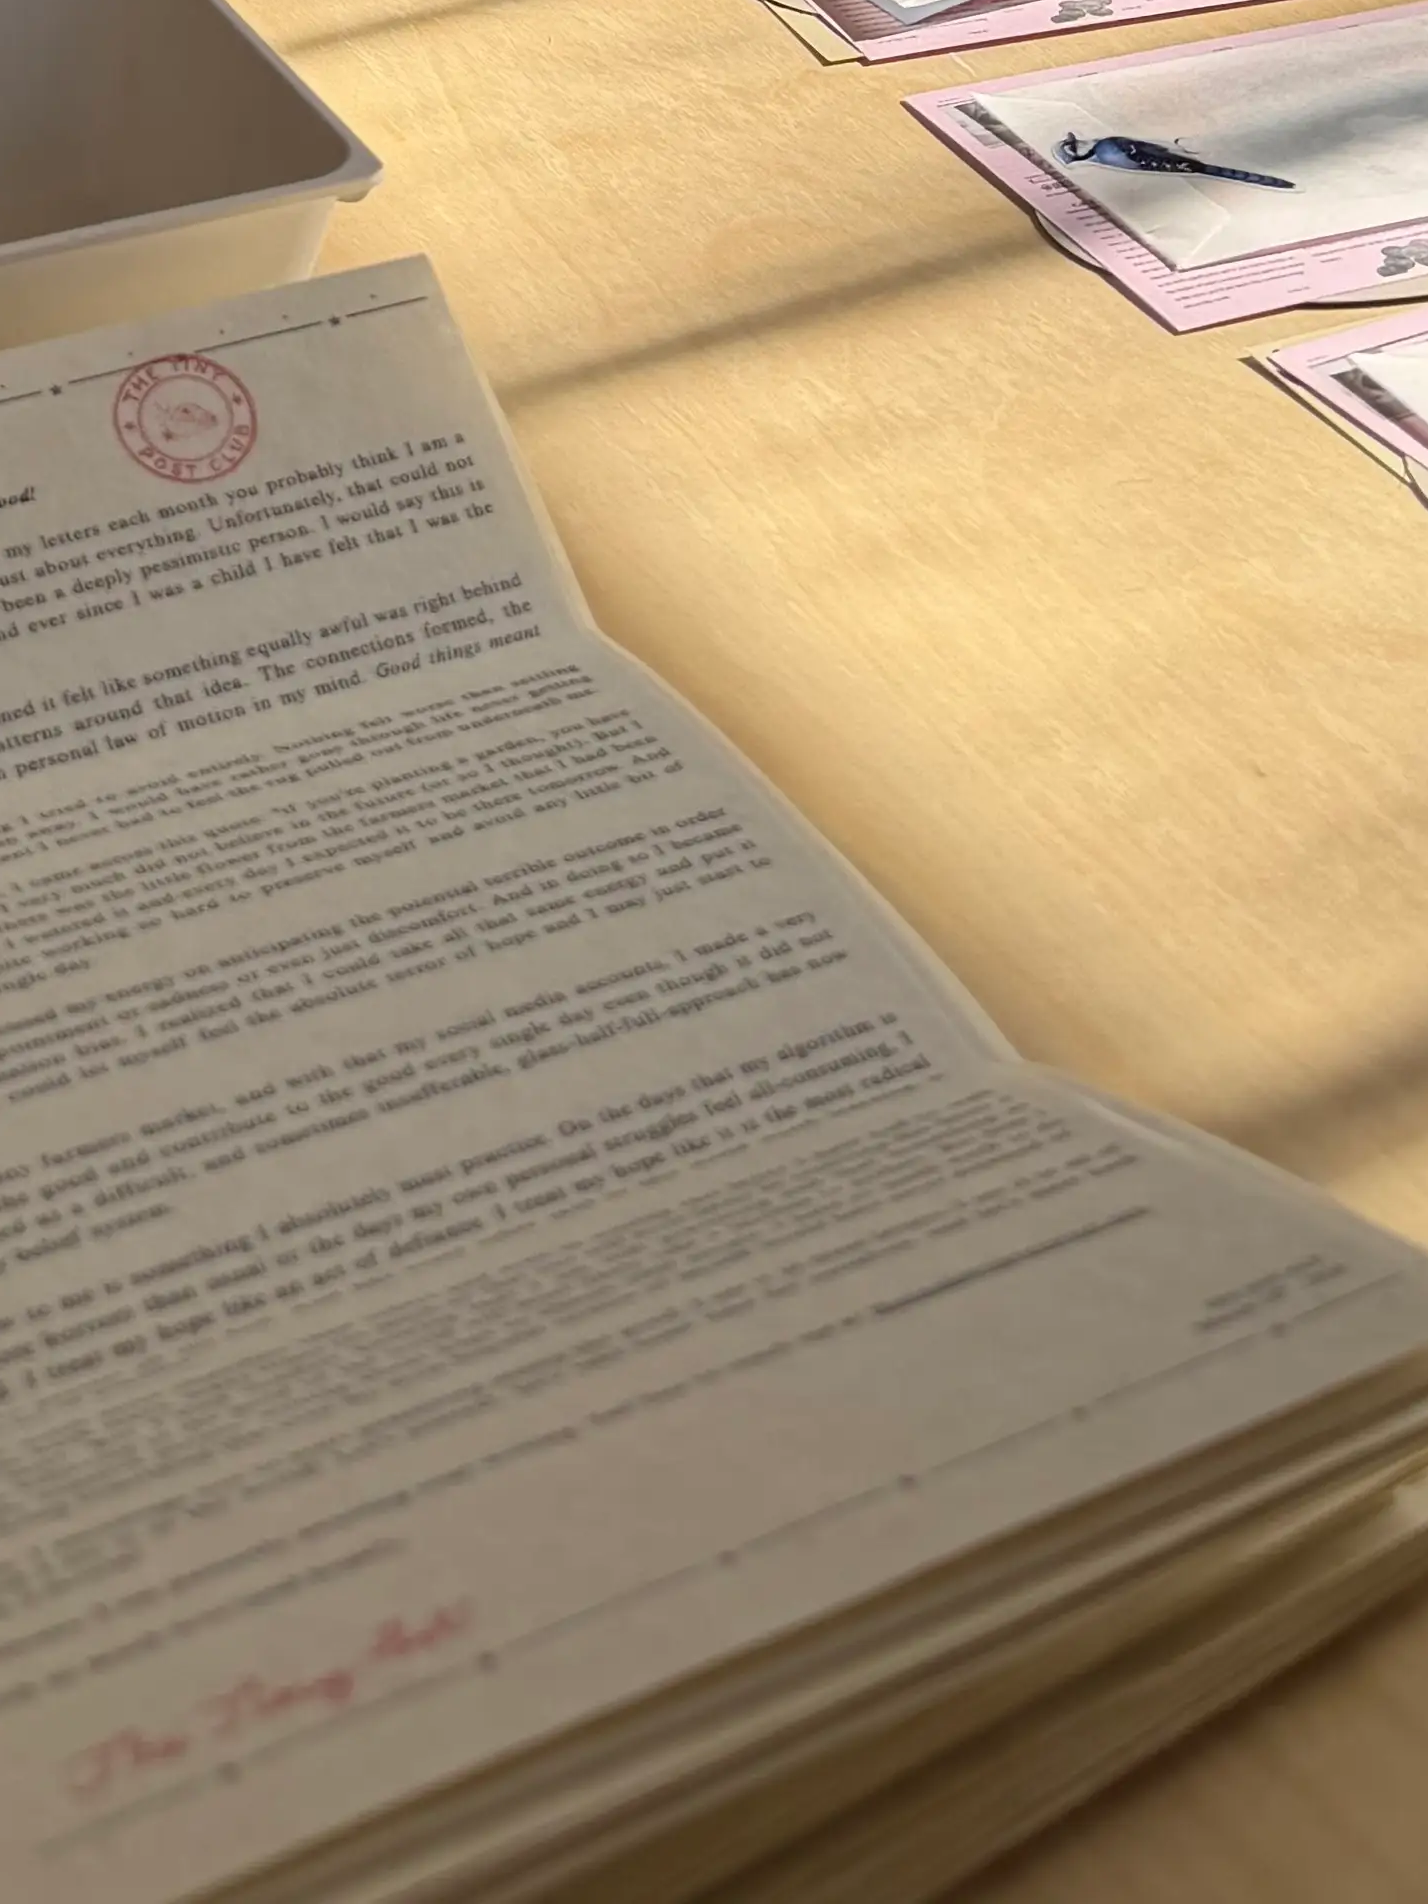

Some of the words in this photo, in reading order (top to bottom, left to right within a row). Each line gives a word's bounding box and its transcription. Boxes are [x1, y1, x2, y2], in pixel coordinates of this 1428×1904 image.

[169, 356, 229, 383] TINY
[1, 541, 33, 560] my
[37, 523, 102, 551] letters
[105, 508, 152, 533] each
[154, 491, 220, 521] month
[222, 483, 261, 508] you
[263, 460, 344, 497] probably
[349, 444, 401, 471] think
[418, 435, 449, 454] am
[137, 446, 199, 480] POST
[208, 424, 252, 473] CLUB
[25, 611, 68, 635] ever
[74, 597, 125, 622] since
[146, 582, 186, 602] was
[207, 558, 258, 587] child
[277, 546, 324, 569] have
[325, 533, 361, 556] felt
[364, 524, 405, 546] that
[423, 510, 461, 529] was
[462, 501, 495, 521] the
[32, 552, 91, 580] about
[93, 526, 199, 563] everything.
[204, 487, 344, 535] Unfortunately,
[344, 476, 385, 498] that
[387, 459, 441, 488] could
[443, 453, 476, 474] not
[69, 566, 133, 596] deeply
[137, 540, 242, 583] pessimistic
[245, 523, 316, 554] person.
[333, 497, 392, 527] would
[393, 493, 424, 513] say
[426, 483, 465, 503] this
[466, 477, 487, 493] is
[39, 695, 58, 713] it
[59, 683, 97, 708] felt
[98, 675, 139, 697] like
[140, 648, 244, 687] something
[243, 627, 313, 660] equally
[317, 610, 371, 640] awful
[371, 604, 410, 624] was
[411, 590, 458, 616] right
[458, 570, 524, 602] behind
[255, 661, 297, 683] The
[302, 630, 417, 671] connections
[421, 606, 496, 640] formed,
[499, 598, 533, 619] the
[372, 650, 422, 680] Good
[426, 640, 483, 666] things
[486, 622, 542, 650] meant
